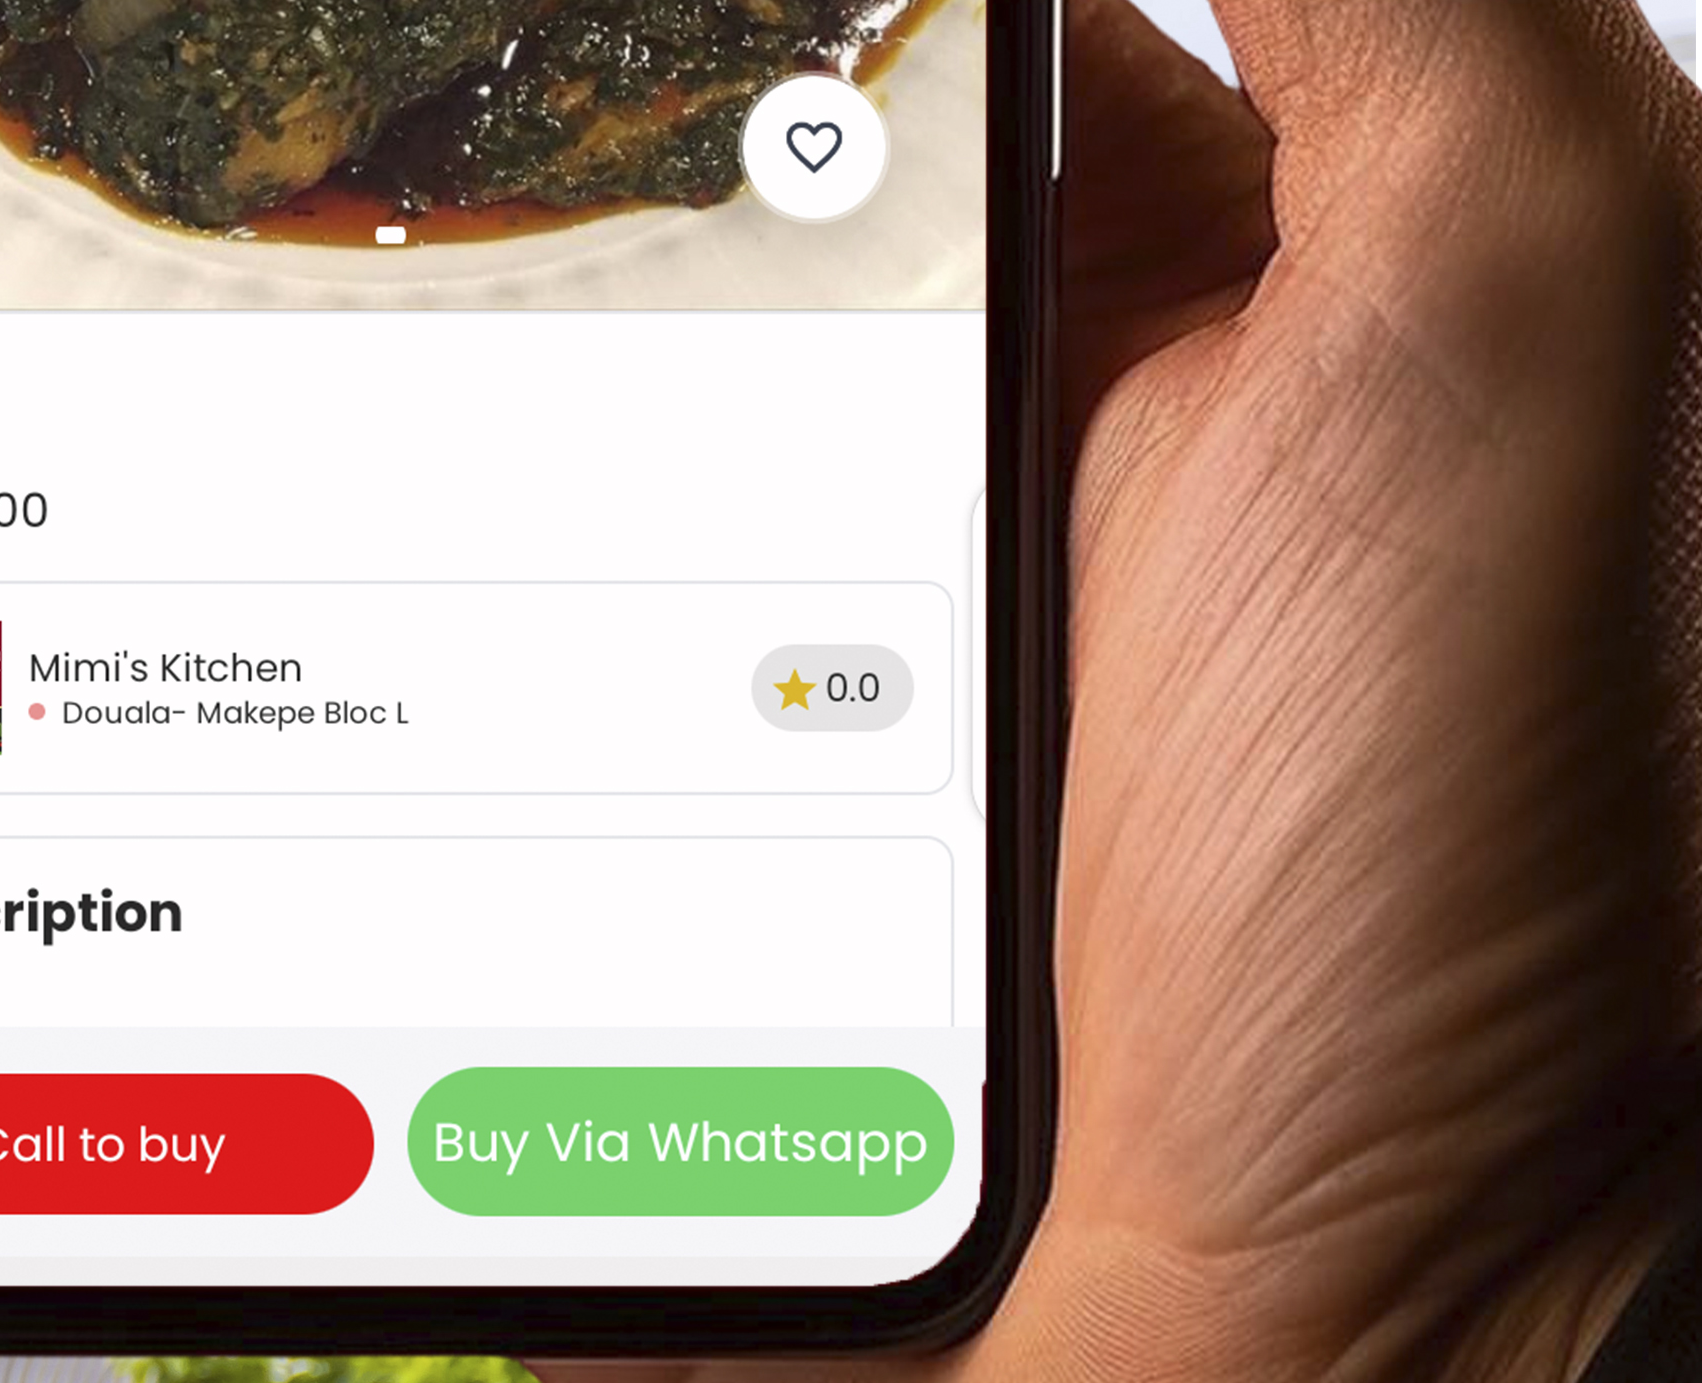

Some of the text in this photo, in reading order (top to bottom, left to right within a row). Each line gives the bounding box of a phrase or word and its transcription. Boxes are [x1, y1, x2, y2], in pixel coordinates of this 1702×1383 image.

[30, 649, 302, 683] Mimi's Kitchen
[826, 672, 880, 703] 0.0
[63, 700, 409, 733] Douala- Makepe Bloc L
[78, 1127, 125, 1163] to
[140, 1124, 226, 1175] buy
[435, 1119, 927, 1176] Buy Via Whatsapp
